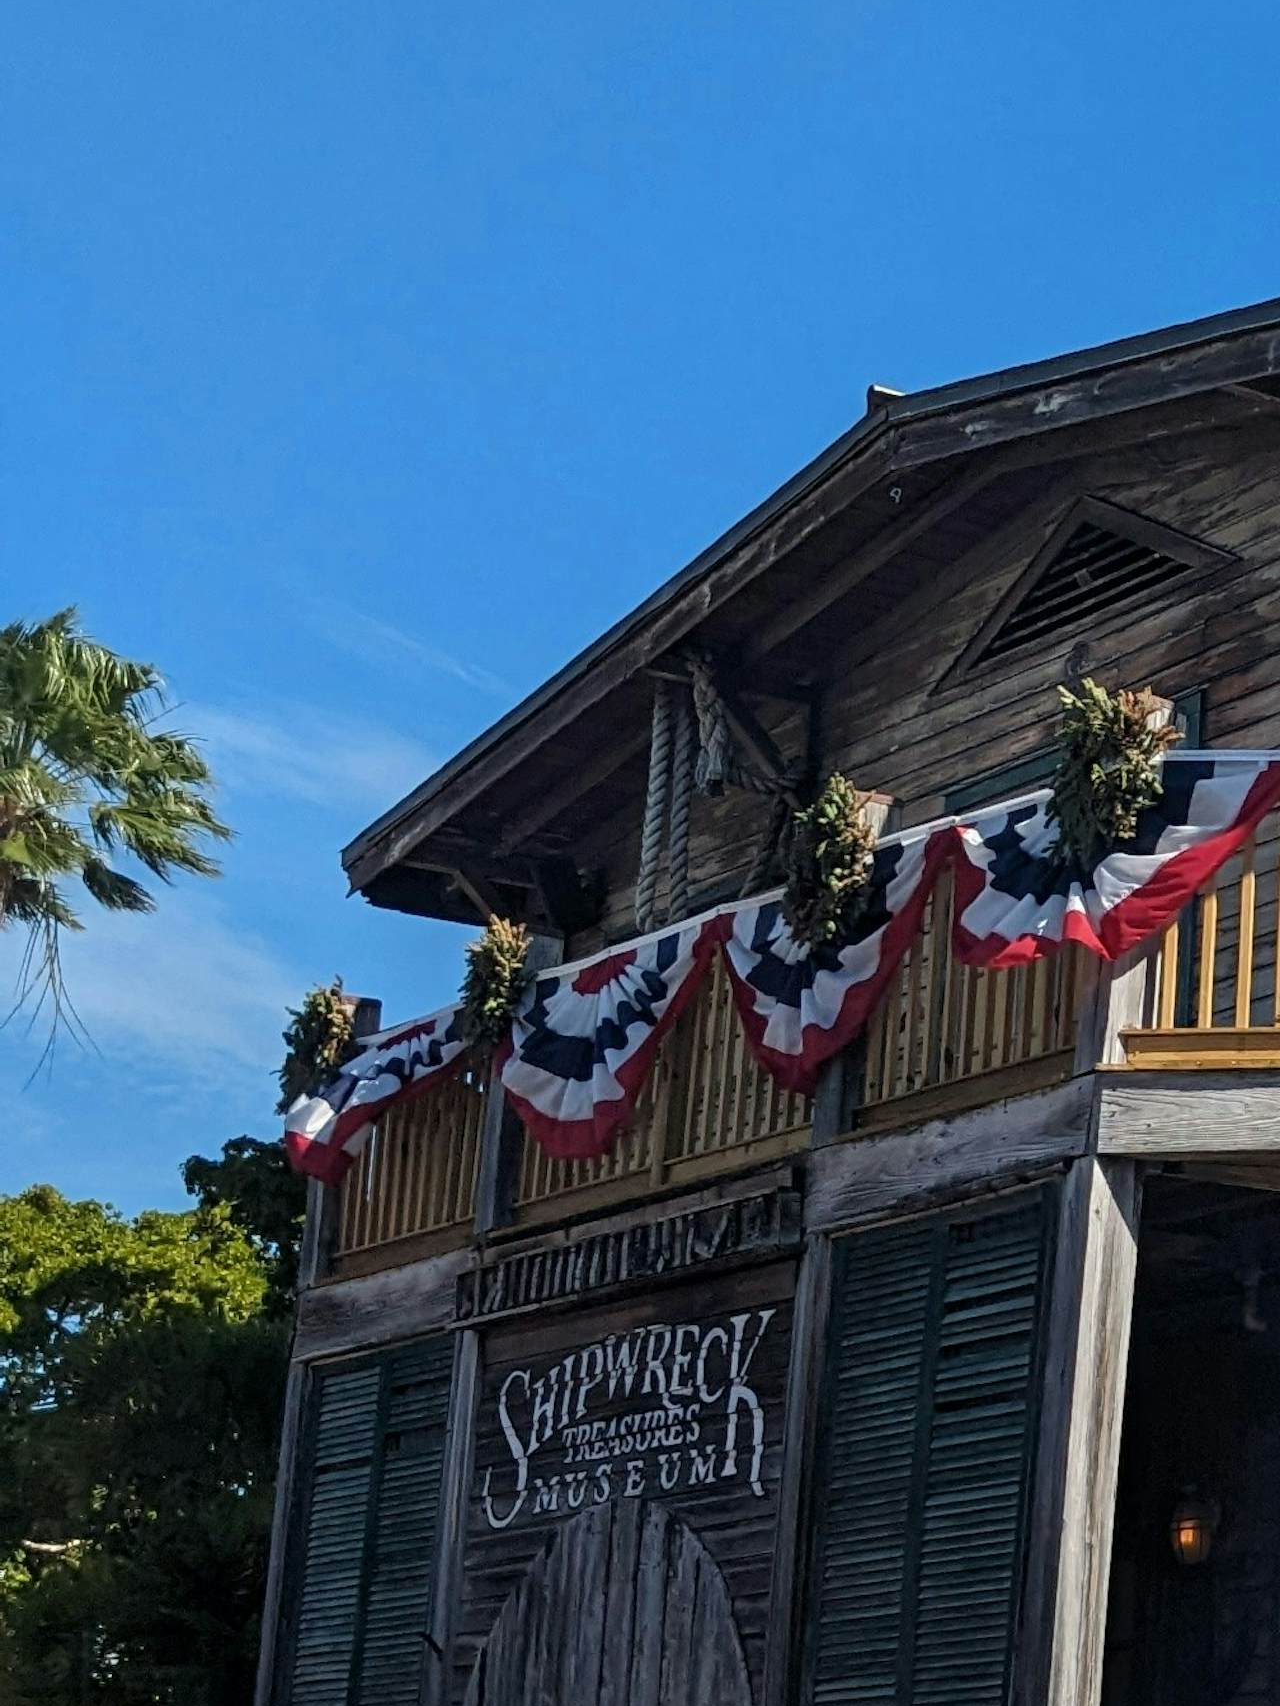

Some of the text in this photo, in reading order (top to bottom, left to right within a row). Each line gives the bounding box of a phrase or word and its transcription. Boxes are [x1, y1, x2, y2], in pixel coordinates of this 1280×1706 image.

[482, 1308, 777, 1529] SHIPWRECK
[562, 1403, 701, 1464] TREASURES
[532, 1444, 718, 1515] MUSEUM
